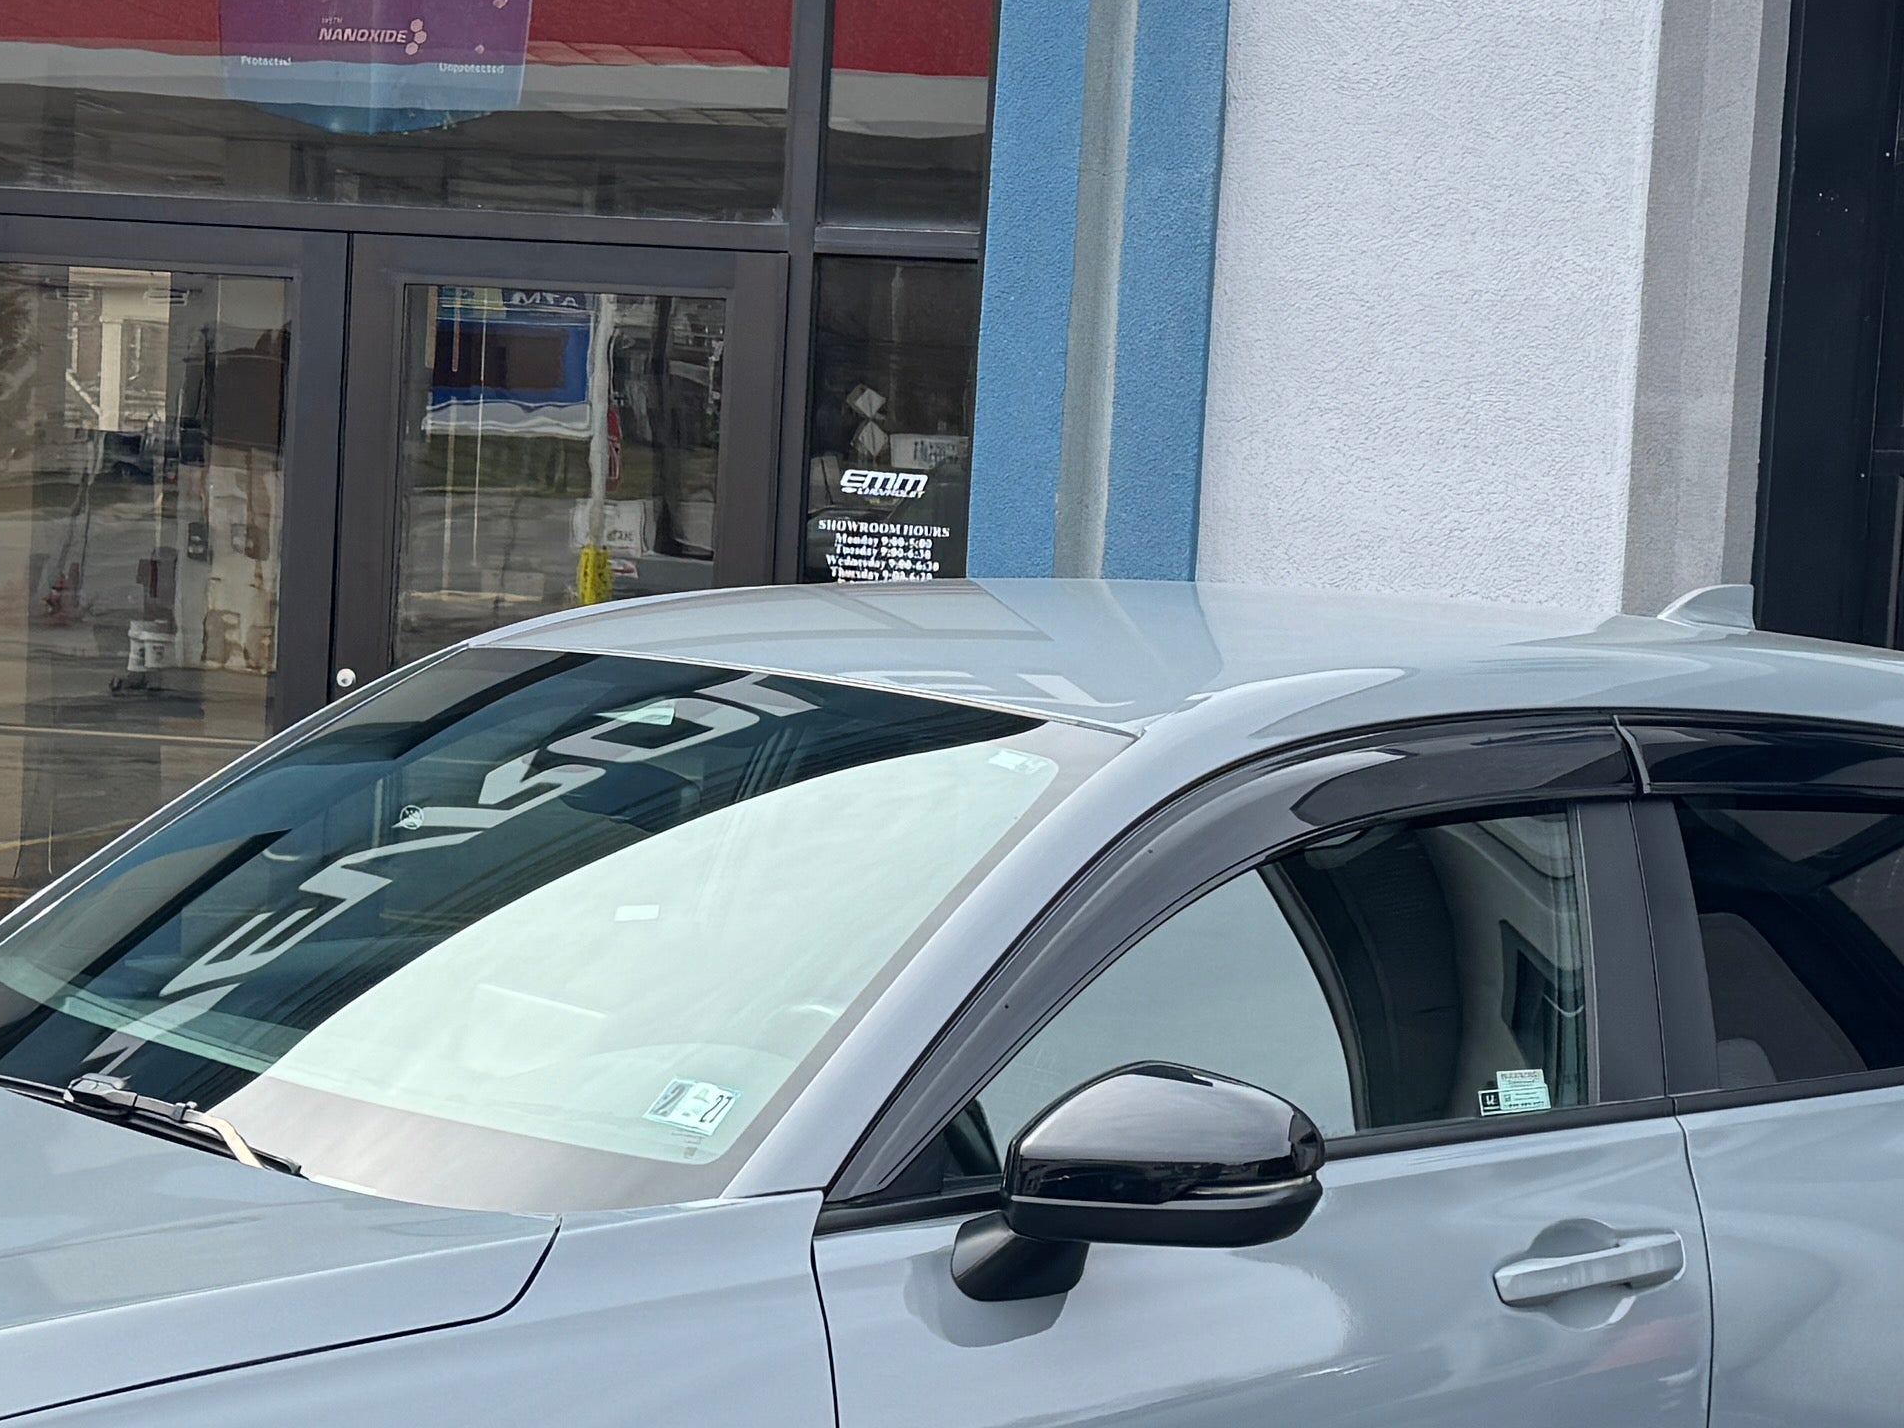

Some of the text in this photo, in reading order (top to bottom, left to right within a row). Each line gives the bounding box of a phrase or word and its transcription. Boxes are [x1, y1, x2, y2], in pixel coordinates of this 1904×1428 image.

[318, 27, 408, 43] NANOXIDE
[818, 519, 951, 538] SHOWROOM HOURS
[835, 532, 879, 548] Monday
[835, 543, 878, 560] Tuesday
[826, 554, 887, 571] Wednesday
[830, 566, 881, 581] Thursday
